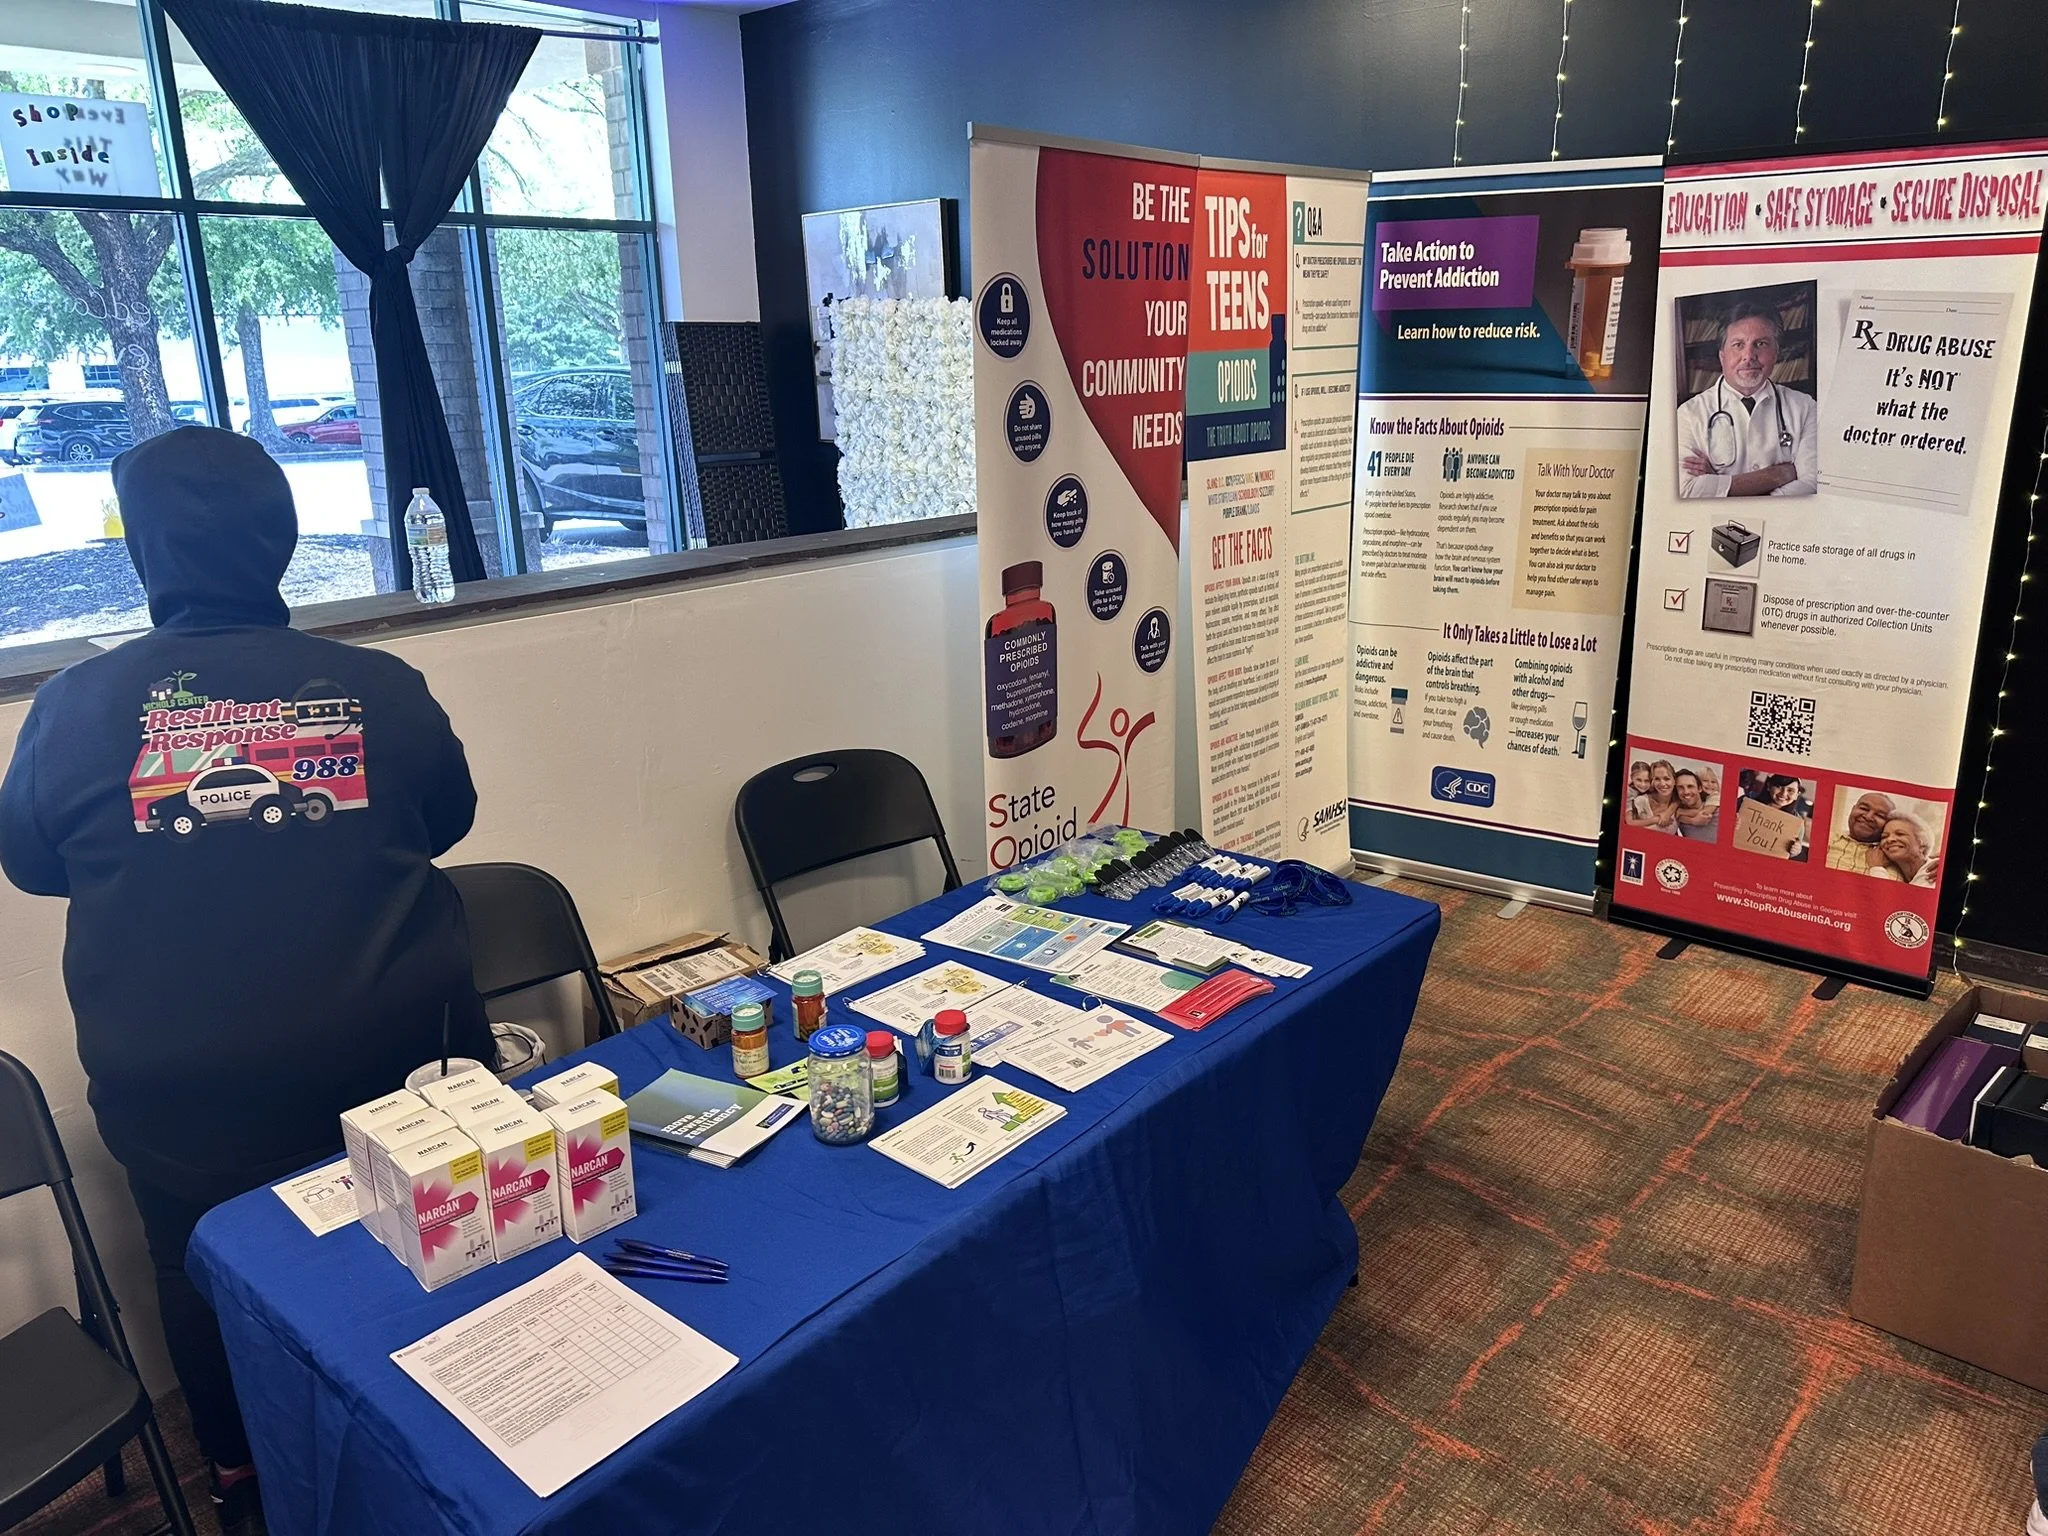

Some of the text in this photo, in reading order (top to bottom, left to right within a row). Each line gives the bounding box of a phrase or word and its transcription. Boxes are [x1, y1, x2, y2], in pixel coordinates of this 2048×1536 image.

[1132, 183, 1190, 224] BE THE
[1666, 169, 2043, 236] EDUCATION SAFE STORAGE SECURE DISPOSAL
[1205, 195, 1268, 260] TIPS for
[1307, 206, 1322, 236] Q&A
[1082, 238, 1189, 281] SOLUTION
[1381, 240, 1475, 263] Take Action to
[1380, 267, 1499, 290] Prevent Addiction
[1206, 270, 1270, 332] TEENS
[1145, 300, 1187, 337] YOUR
[1398, 322, 1541, 340] Learn how to reduce risk.
[1885, 332, 1932, 355] DRUG
[1935, 336, 1996, 359] ABUSE
[1082, 356, 1186, 397] COMMUNITY
[1217, 358, 1257, 404] OPIOIDS
[1885, 367, 1958, 391] It's NOT
[1876, 399, 1949, 421] what the
[1132, 411, 1183, 450] NEEDS
[1206, 427, 1216, 447] THE
[1217, 424, 1232, 446] TRUTH
[1233, 423, 1249, 444] ABOUT
[1369, 417, 1505, 440] Know the Facts About Opioids
[1843, 426, 1967, 454] doctor ordered.
[1367, 451, 1382, 477] 41
[1384, 452, 1415, 463] PEOPLE DIE
[1467, 454, 1500, 465] ANYONE CAN
[1384, 466, 1412, 477] EVERY DAY
[1466, 468, 1515, 480] BECOME ADDICTED
[1538, 463, 1615, 479] Talk With Your Doctor
[1212, 526, 1273, 570] GET THE FACTS
[1768, 540, 1916, 560] Practice safe storage of all drugs in
[1767, 553, 1807, 565] the home.
[1763, 594, 1950, 621] Dispose of prescription and over-the-counter
[1760, 621, 1837, 637] whenever possible.
[1761, 607, 1933, 634] (OTC) drugs in authorized Collection Units
[1004, 631, 1047, 652] COMMONLY
[1443, 622, 1597, 652] It Only Takes a Little to Lose a Lot
[999, 642, 1048, 663] PRESCRIBED
[1356, 645, 1397, 657] Opioids can be
[1427, 651, 1493, 668] Opioids affect the part
[1010, 657, 1040, 673] OPIOIDS
[1356, 658, 1394, 670] addictive and
[1426, 666, 1474, 679] of the brain that
[1514, 658, 1573, 674] Combining opioids
[1355, 671, 1386, 684] dangerous.
[1425, 679, 1481, 696] controls breathing.
[1513, 673, 1564, 687] with alcohol and
[143, 695, 209, 711] NICHOLS CENTER
[1512, 687, 1529, 698] other
[145, 698, 282, 732] Resilient
[147, 723, 298, 753] Response
[1544, 733, 1559, 742] your
[1507, 742, 1559, 756] chances of death.
[292, 755, 359, 781] 988
[200, 790, 251, 805] POLICE
[1466, 782, 1488, 795] CDC
[988, 785, 1055, 829] State
[1748, 806, 1784, 835] Thank
[990, 806, 1077, 870] Opioid
[1716, 892, 1851, 932] www.StopRxAbuseinGA.org
[447, 1078, 476, 1091] NARCAN
[560, 1072, 587, 1086] NARCAN
[369, 1100, 398, 1114] NARCAN
[471, 1097, 500, 1111] NARCAN
[569, 1099, 596, 1113] NARCAN
[396, 1118, 425, 1133] NARCAN
[494, 1118, 523, 1133] NARCAN
[661, 1114, 696, 1133] move
[671, 1107, 721, 1136] towards
[684, 1103, 743, 1139] resiliency
[417, 1140, 448, 1156] NARCAN
[571, 1153, 609, 1179] NARCAN
[492, 1176, 532, 1200] NARCAN
[418, 1199, 460, 1226] NARCAN
